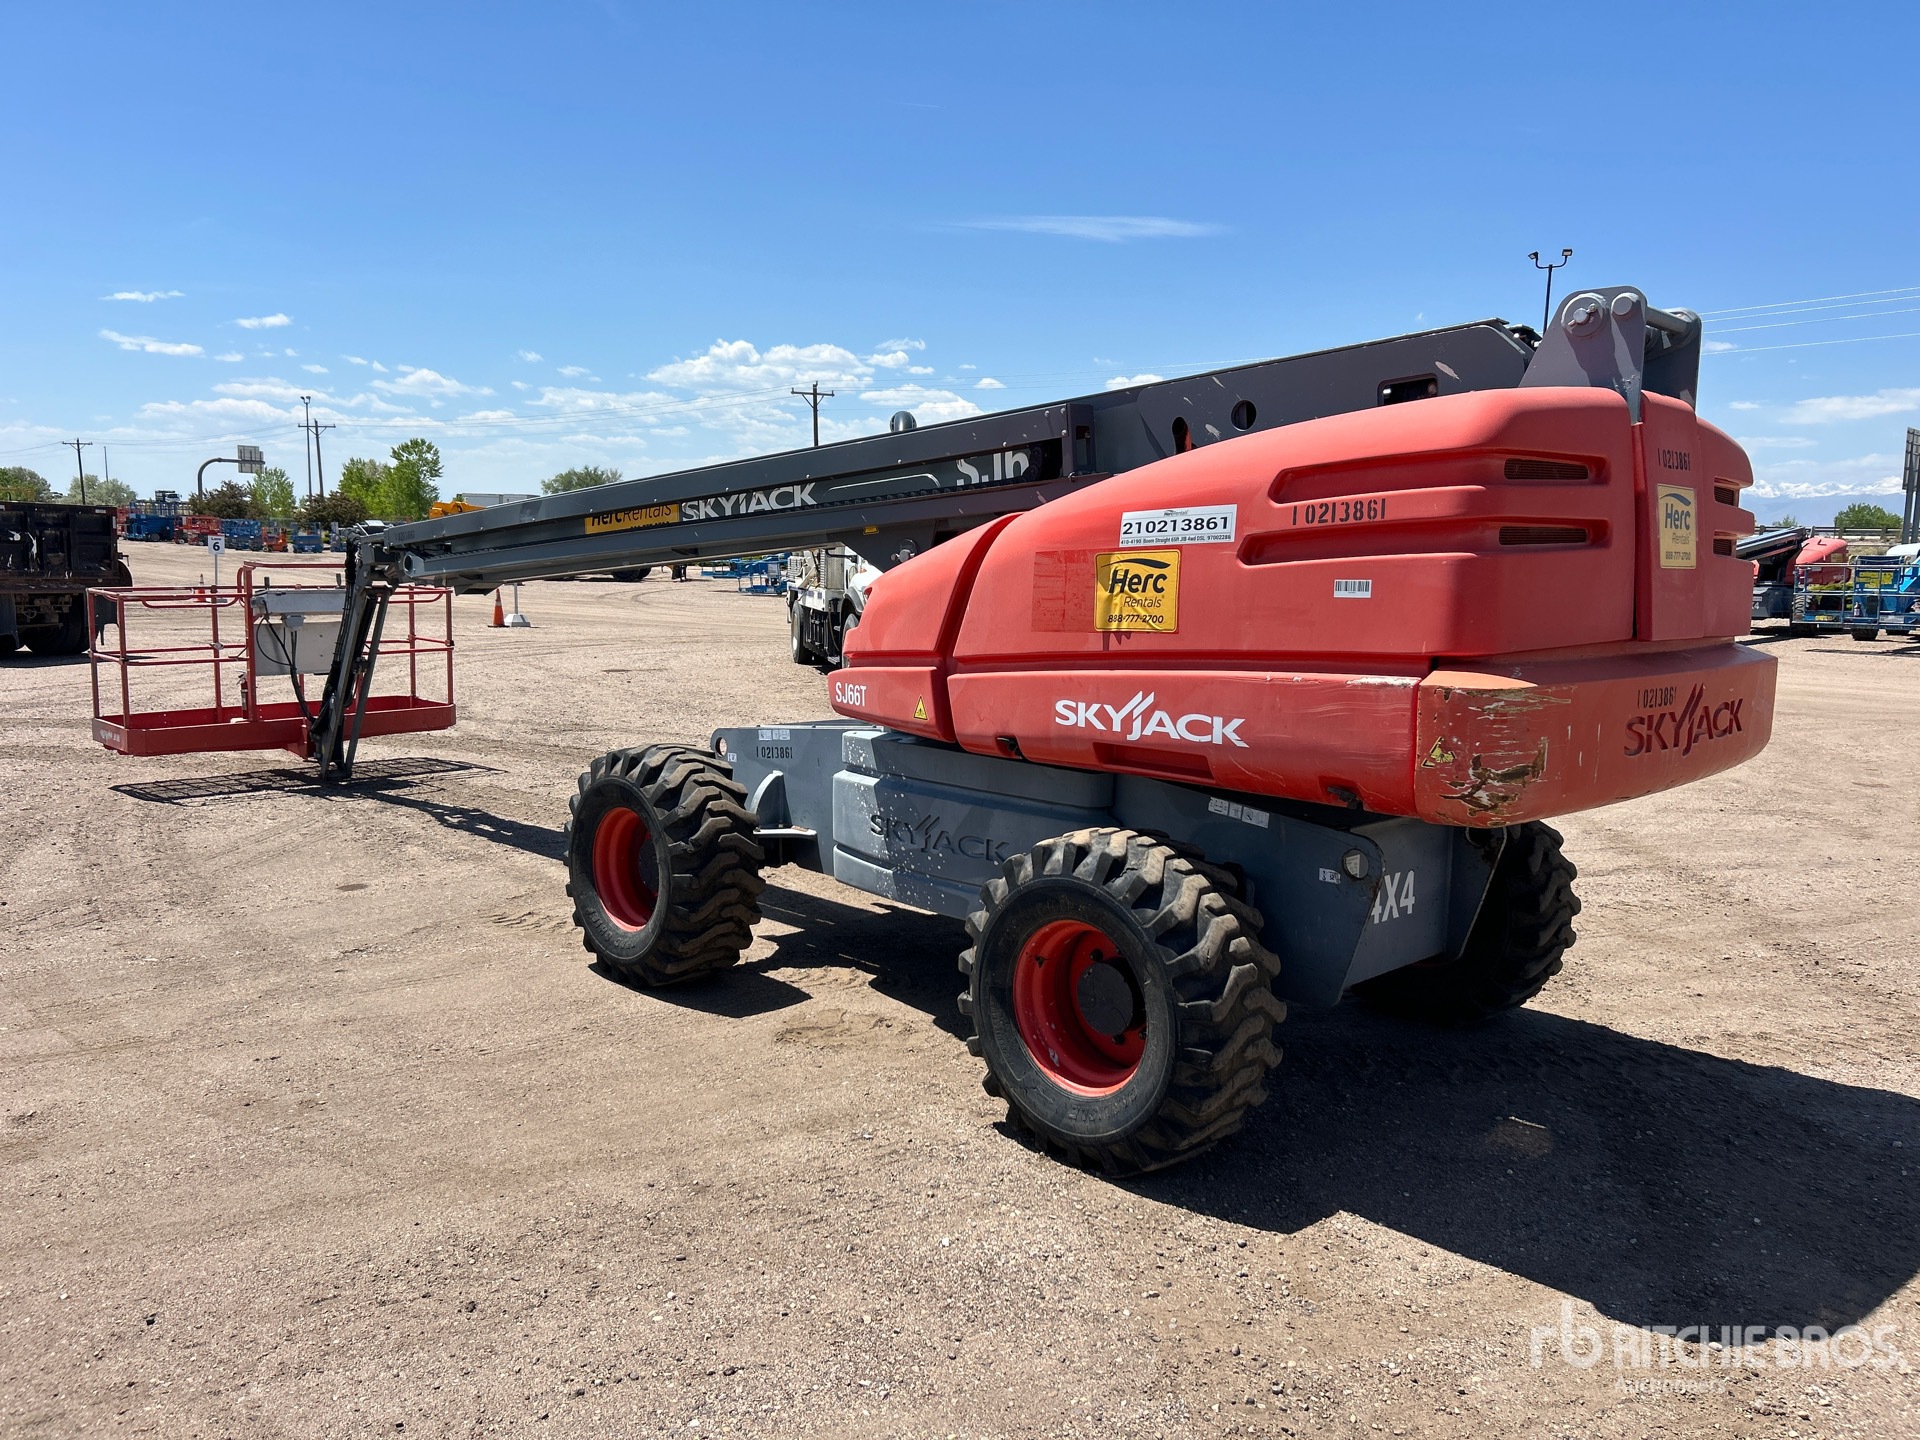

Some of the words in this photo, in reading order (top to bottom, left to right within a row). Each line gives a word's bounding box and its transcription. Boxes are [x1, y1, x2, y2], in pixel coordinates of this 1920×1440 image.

[1122, 516, 1228, 535] 210213861
[1665, 503, 1691, 530] Herc
[213, 542, 220, 551] 6
[1108, 568, 1167, 594] Herc
[1123, 596, 1162, 608] Rentals
[1107, 614, 1164, 624] 888-777-2700
[835, 681, 867, 707] SJ66T
[1055, 690, 1249, 748] SKYJACK
[1624, 682, 1743, 757] SKYJACK
[870, 814, 1010, 863] SKYJACK
[1370, 869, 1416, 925] 4X4
